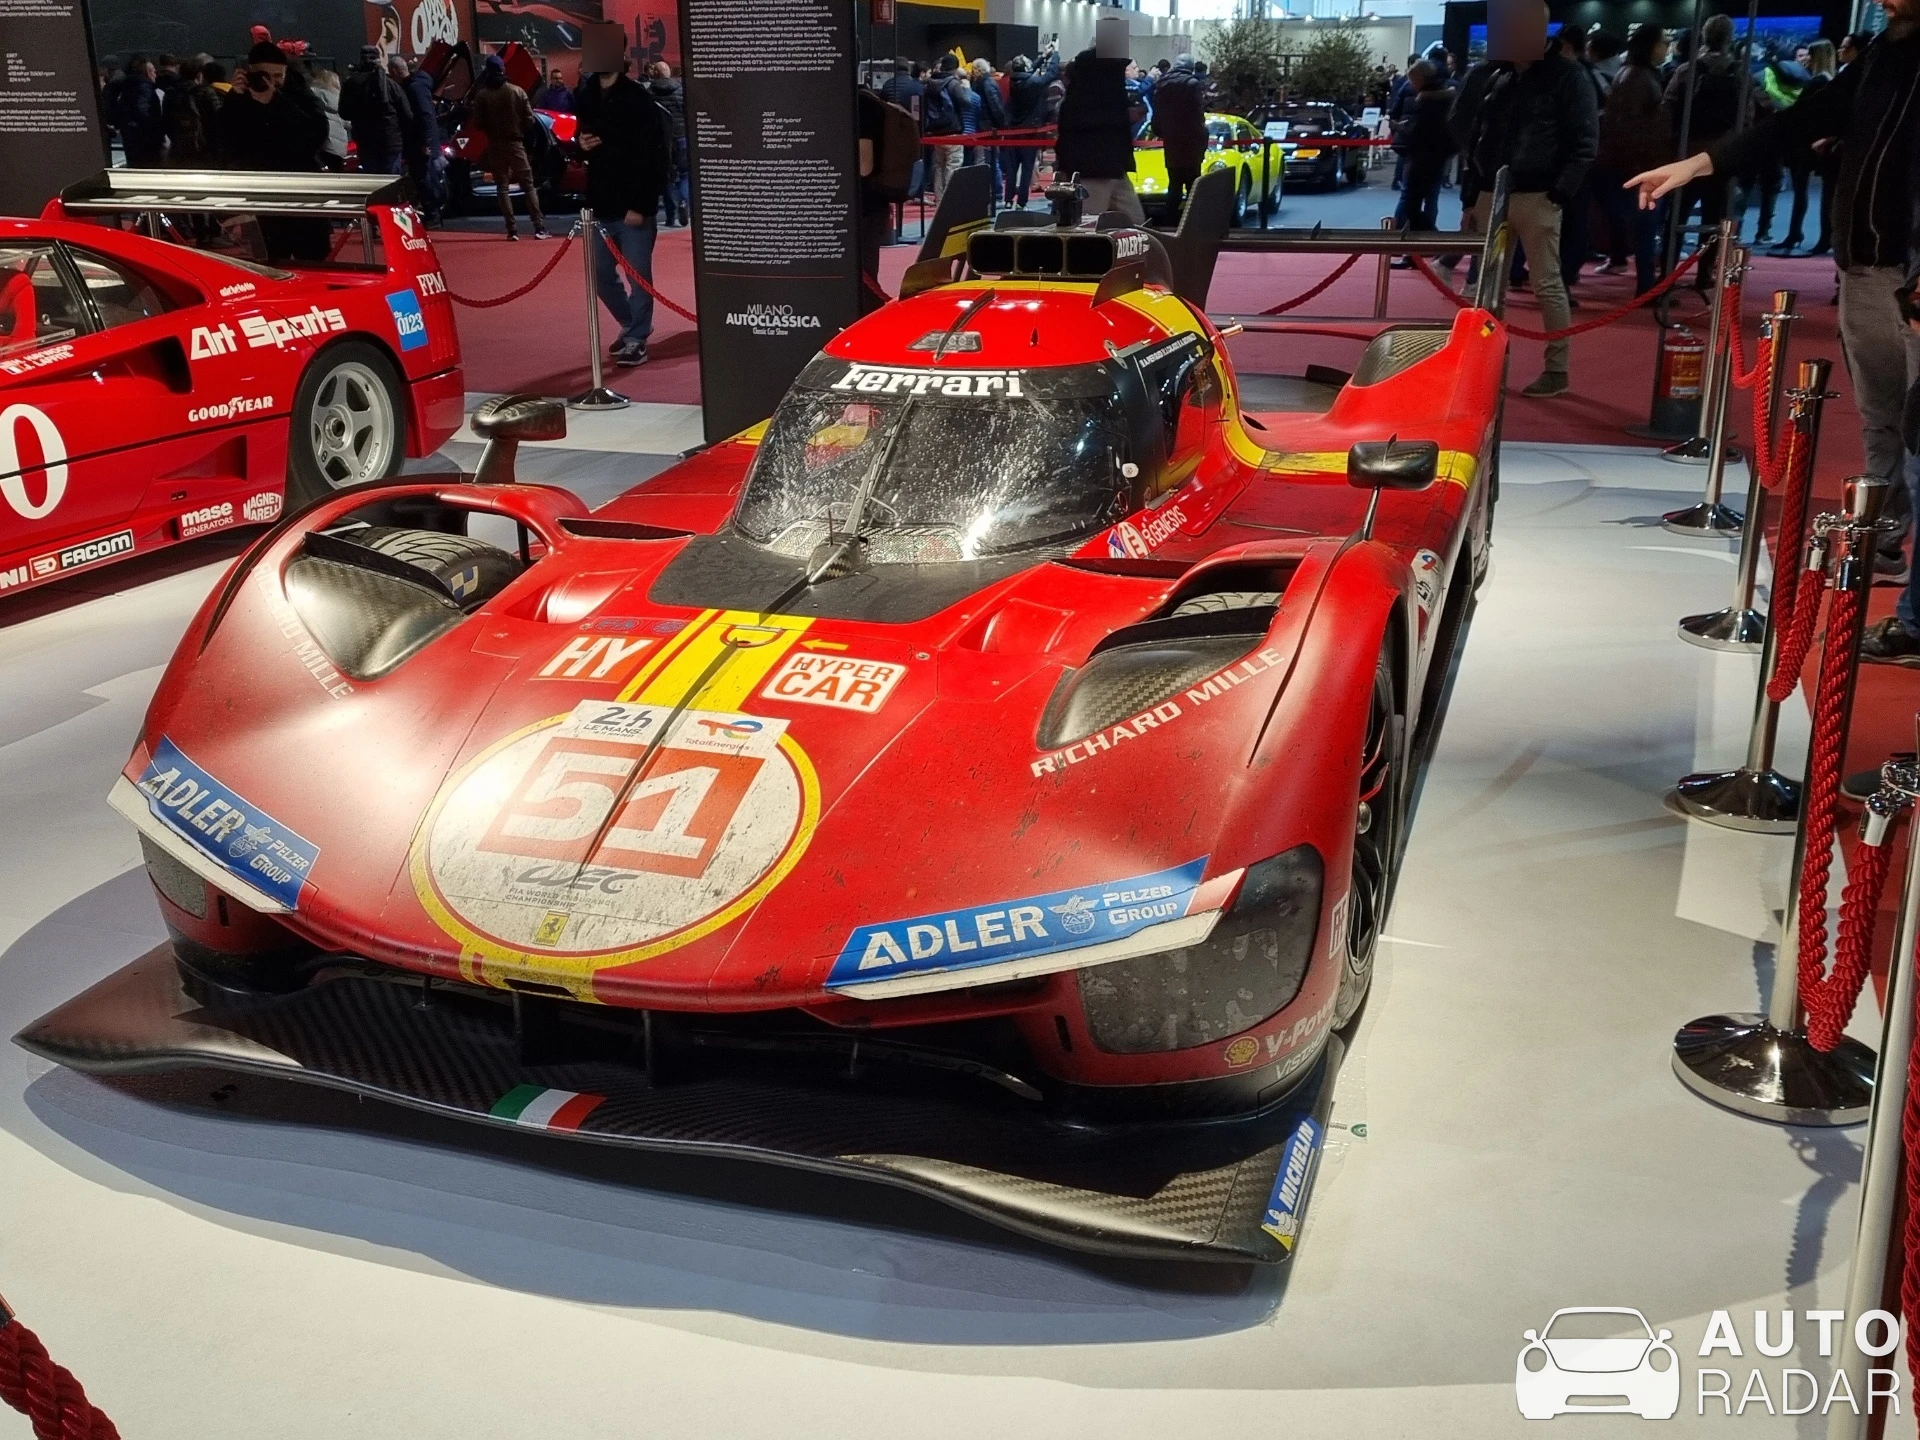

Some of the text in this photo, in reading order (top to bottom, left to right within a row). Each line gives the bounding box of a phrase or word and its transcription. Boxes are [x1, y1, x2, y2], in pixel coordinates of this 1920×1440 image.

[401, 234, 428, 252] Group
[416, 271, 447, 297] FPM
[725, 312, 822, 328] AUTOCLASSICA
[746, 303, 794, 316] MILANO
[190, 304, 348, 361] Art Sports
[752, 327, 767, 336] Classic
[776, 328, 789, 336] Show
[830, 363, 1024, 398] Ferrari
[181, 502, 234, 528] mase
[182, 517, 235, 538] GENERATORS
[1148, 505, 1187, 542] GENESYS
[61, 534, 133, 568] FACOM
[293, 641, 354, 701] MILLE
[538, 637, 654, 678] HY
[791, 657, 894, 683] HYPER
[784, 672, 882, 707] CAR
[1030, 647, 1285, 778] RICHARD MILLE
[582, 724, 601, 732] LE
[602, 725, 642, 736] MANS
[685, 738, 750, 752] TotalEnergies
[139, 767, 246, 844] ADLER
[506, 751, 720, 860] 51
[249, 853, 292, 885] GROUP
[267, 840, 310, 872] PELZER
[515, 865, 639, 895] WEC
[526, 889, 560, 900] WORLD
[505, 894, 578, 909] CHAMPIONSHIP
[1102, 885, 1173, 908] PELZER
[1107, 902, 1178, 926] GROUP
[857, 905, 1049, 971] ADLER
[1278, 1120, 1315, 1211] MICHELIN
